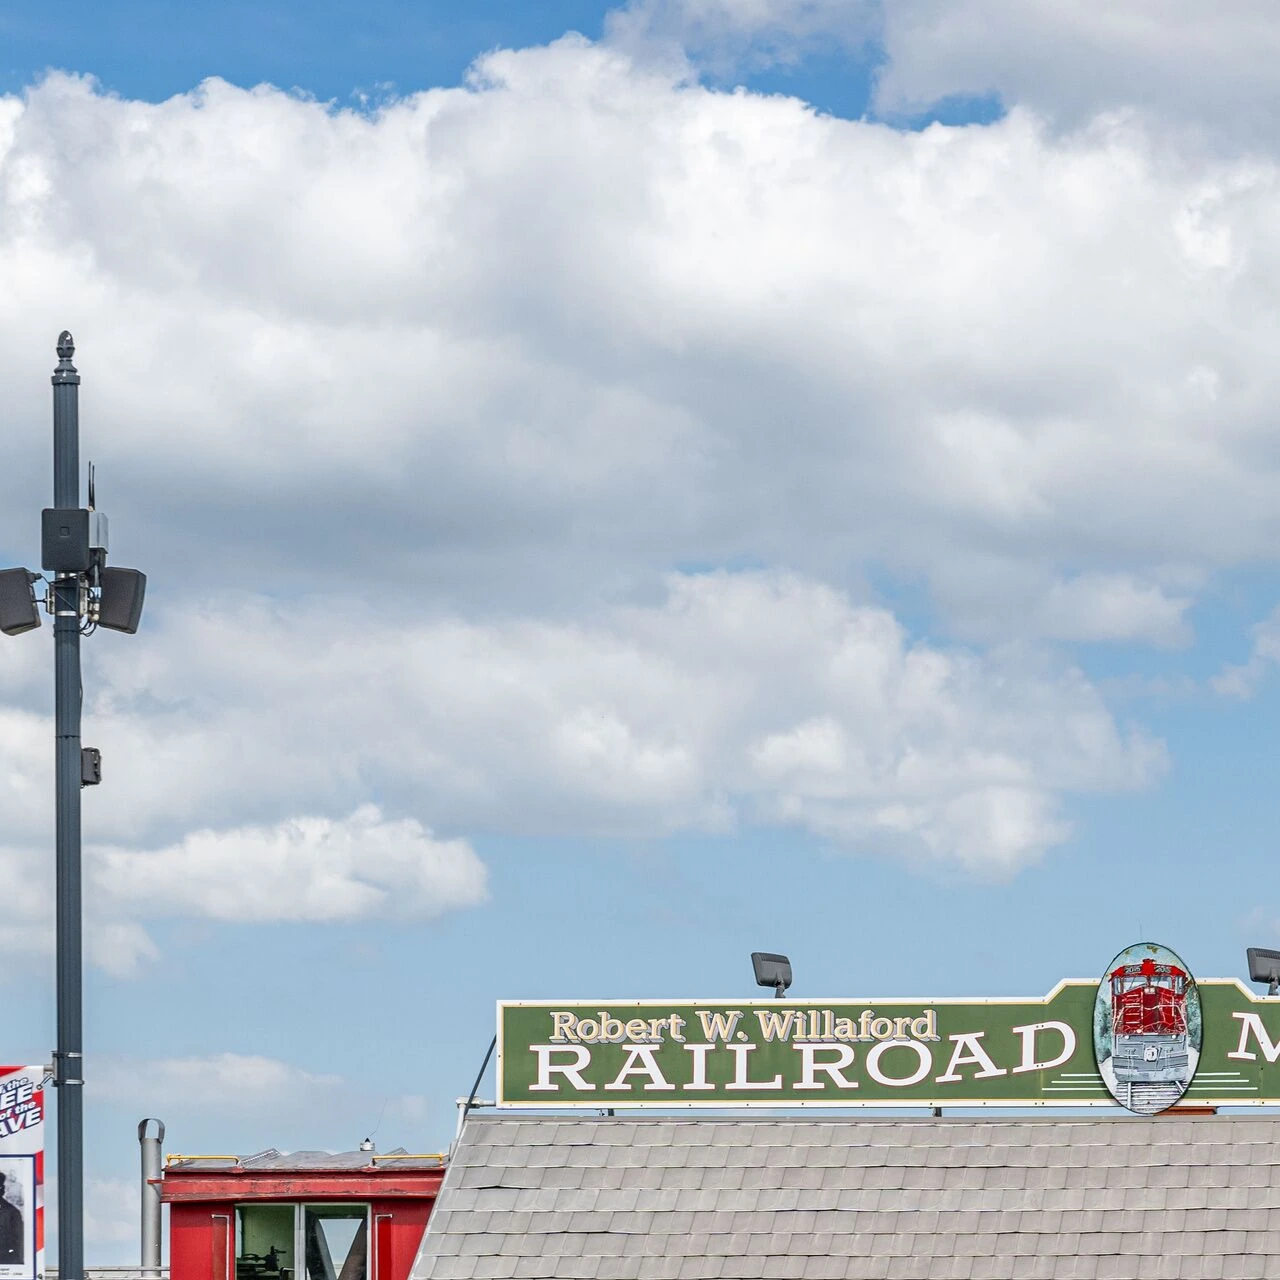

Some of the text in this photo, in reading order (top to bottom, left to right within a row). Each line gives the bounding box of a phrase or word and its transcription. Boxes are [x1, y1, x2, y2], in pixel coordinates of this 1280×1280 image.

[549, 1009, 941, 1043] Robert W. Willaford
[528, 1020, 1077, 1091] RAILROAD
[6, 1077, 29, 1092] the
[15, 1101, 36, 1115] the
